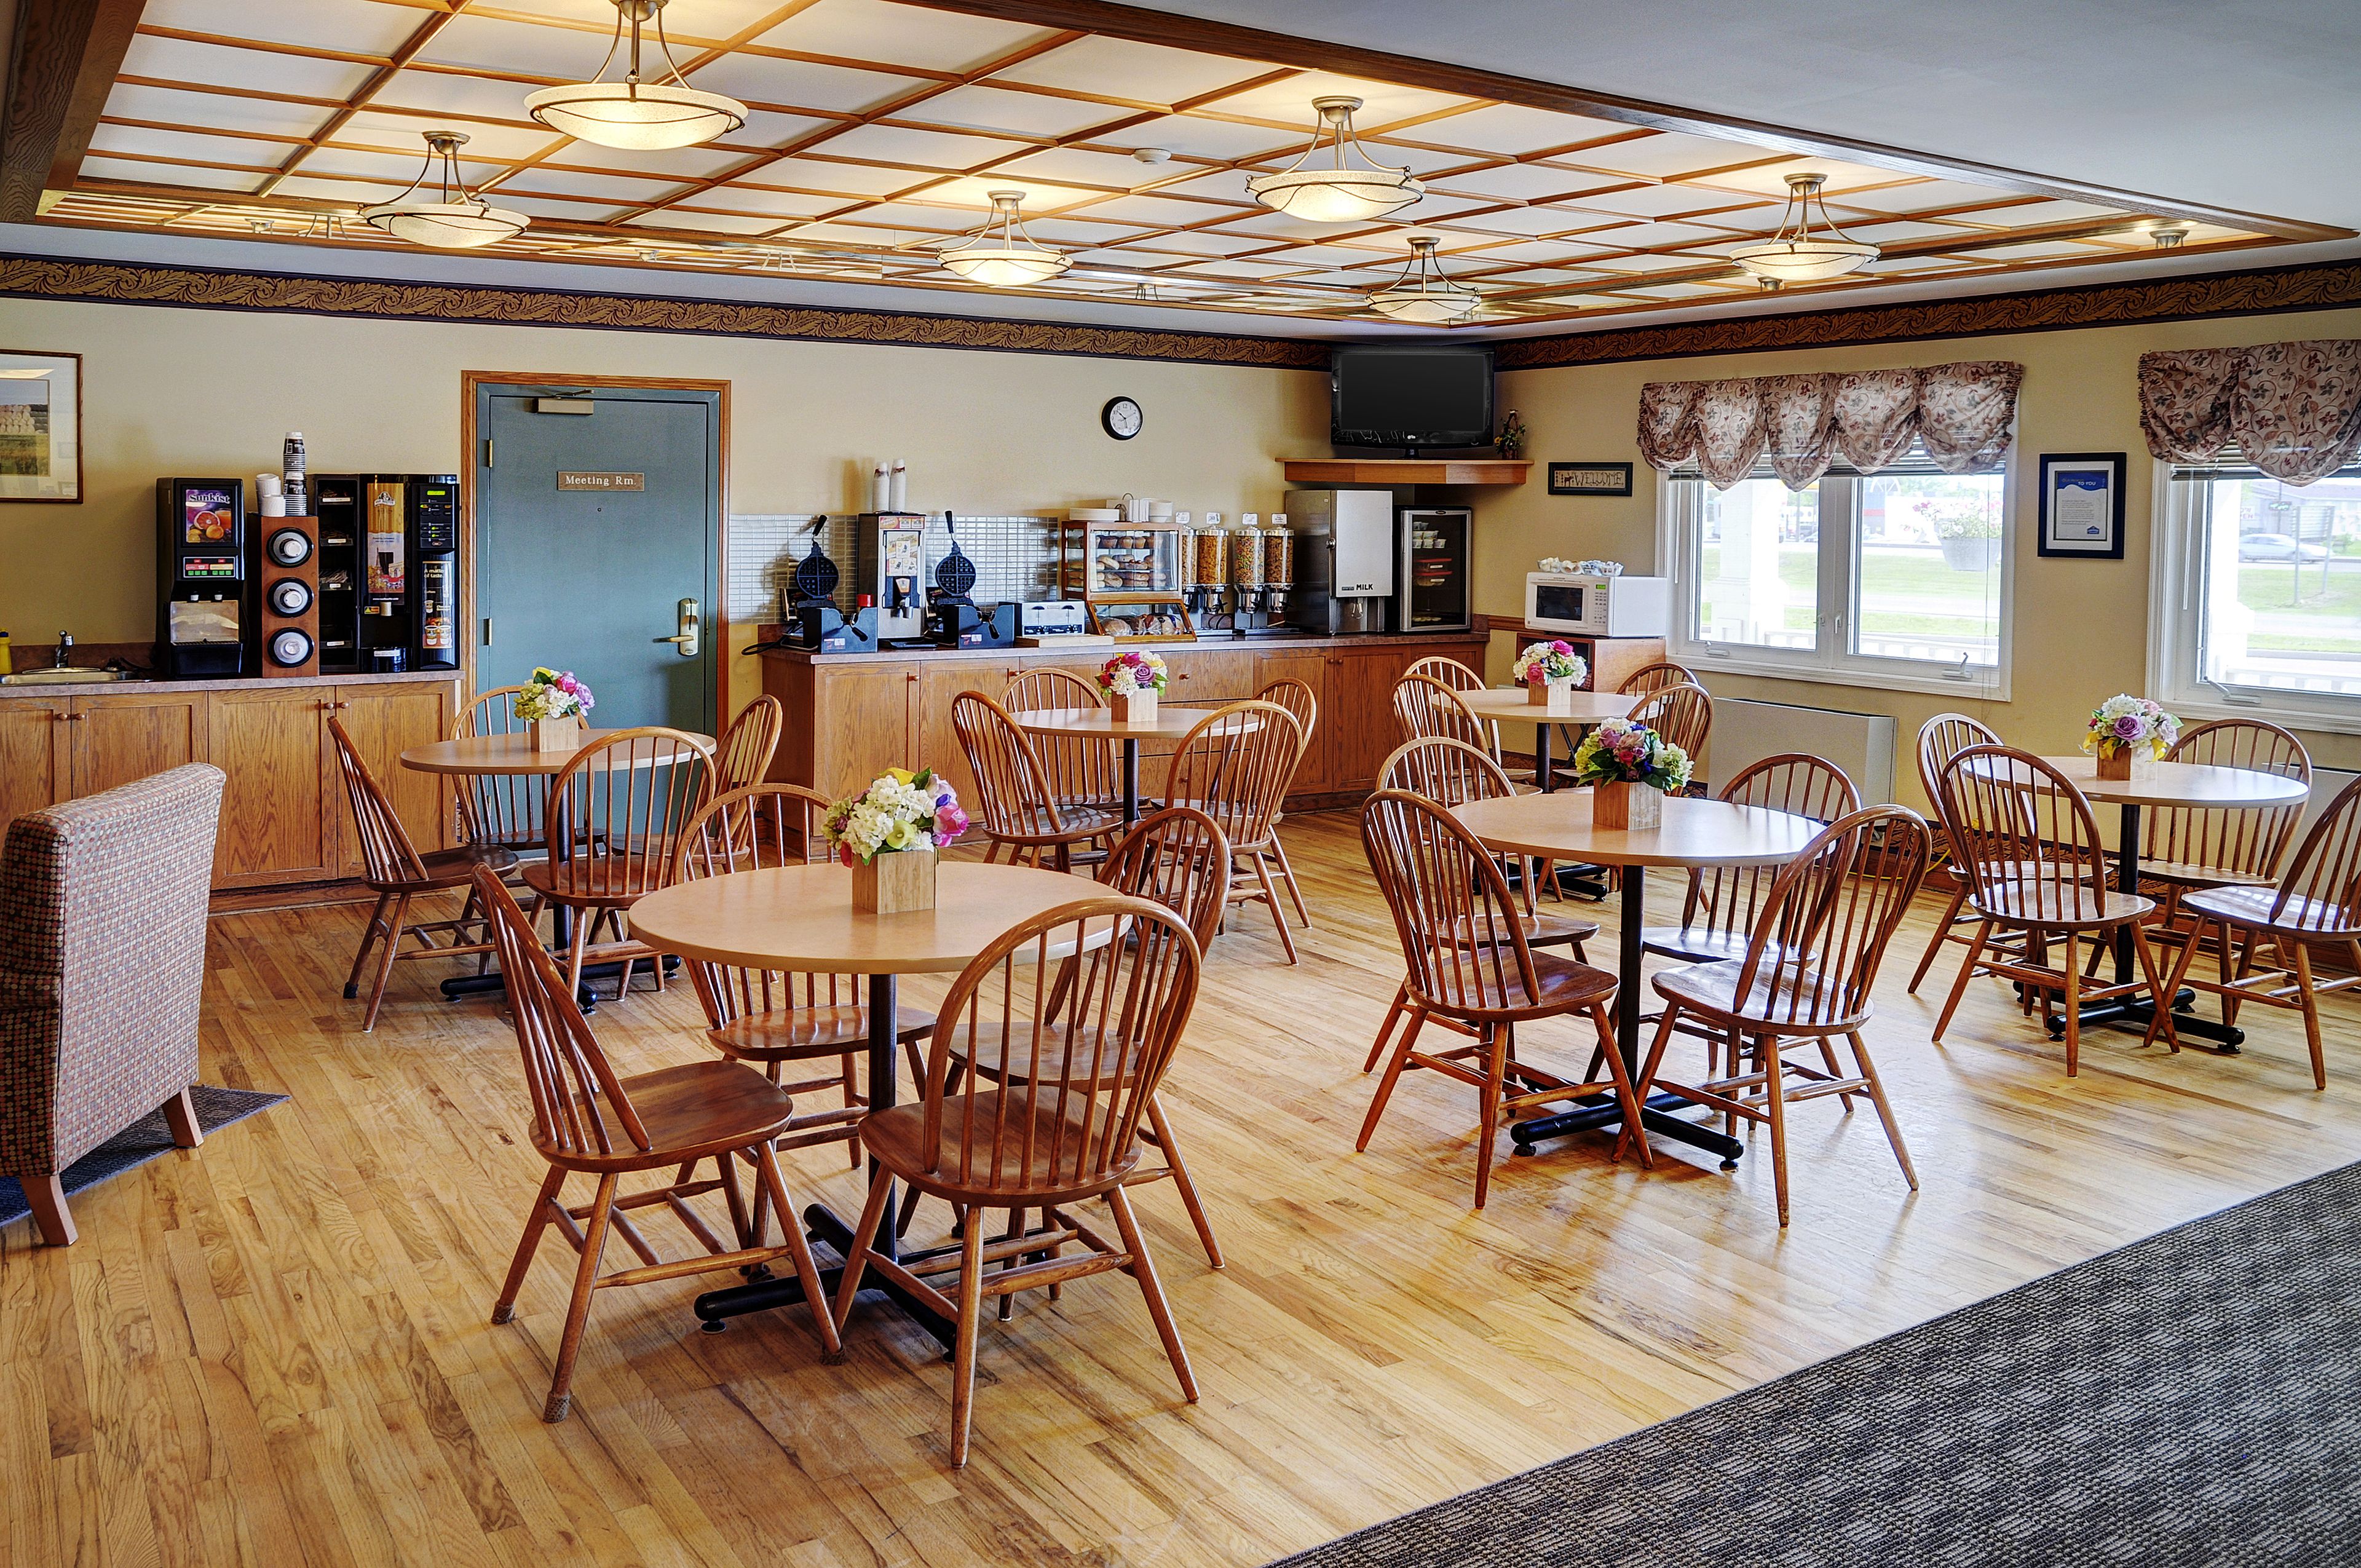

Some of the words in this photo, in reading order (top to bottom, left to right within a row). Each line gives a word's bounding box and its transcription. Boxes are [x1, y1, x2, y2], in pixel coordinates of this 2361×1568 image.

[565, 475, 609, 487] Meeting
[615, 476, 636, 485] Rm.
[1574, 471, 1624, 486] WELCOME
[189, 493, 231, 504] Sunkist
